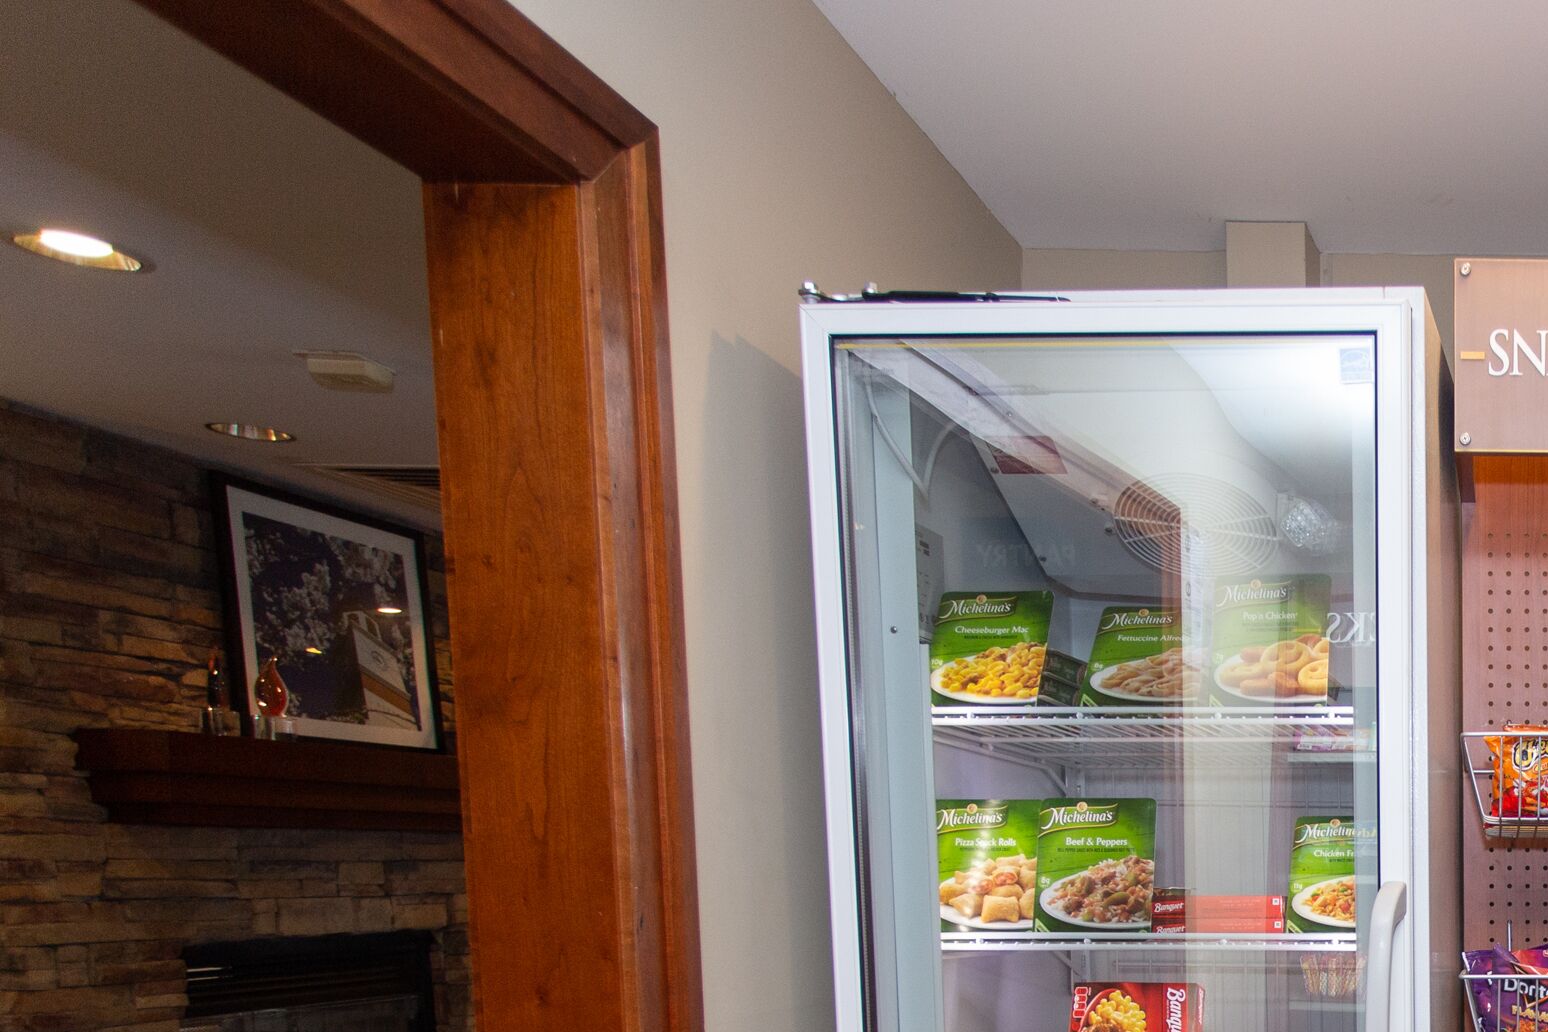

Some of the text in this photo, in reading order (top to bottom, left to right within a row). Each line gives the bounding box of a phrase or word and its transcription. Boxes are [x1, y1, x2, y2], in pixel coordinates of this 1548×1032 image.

[1216, 585, 1288, 607] Michelina's
[939, 599, 1012, 619] Michelina's
[1264, 611, 1296, 619] Chicken
[1101, 612, 1175, 629] Michelina's
[955, 625, 1029, 635] Cheeseburger Mac
[1117, 634, 1159, 642] Fettuccine
[937, 809, 1002, 830] Michelina's
[1040, 807, 1113, 829] Michelina's
[955, 838, 974, 846] Pizza
[998, 838, 1016, 847] Rolls
[1066, 838, 1128, 848] Beef & Peppers
[1314, 850, 1345, 858] Chicken
[1154, 902, 1185, 913] Banquet
